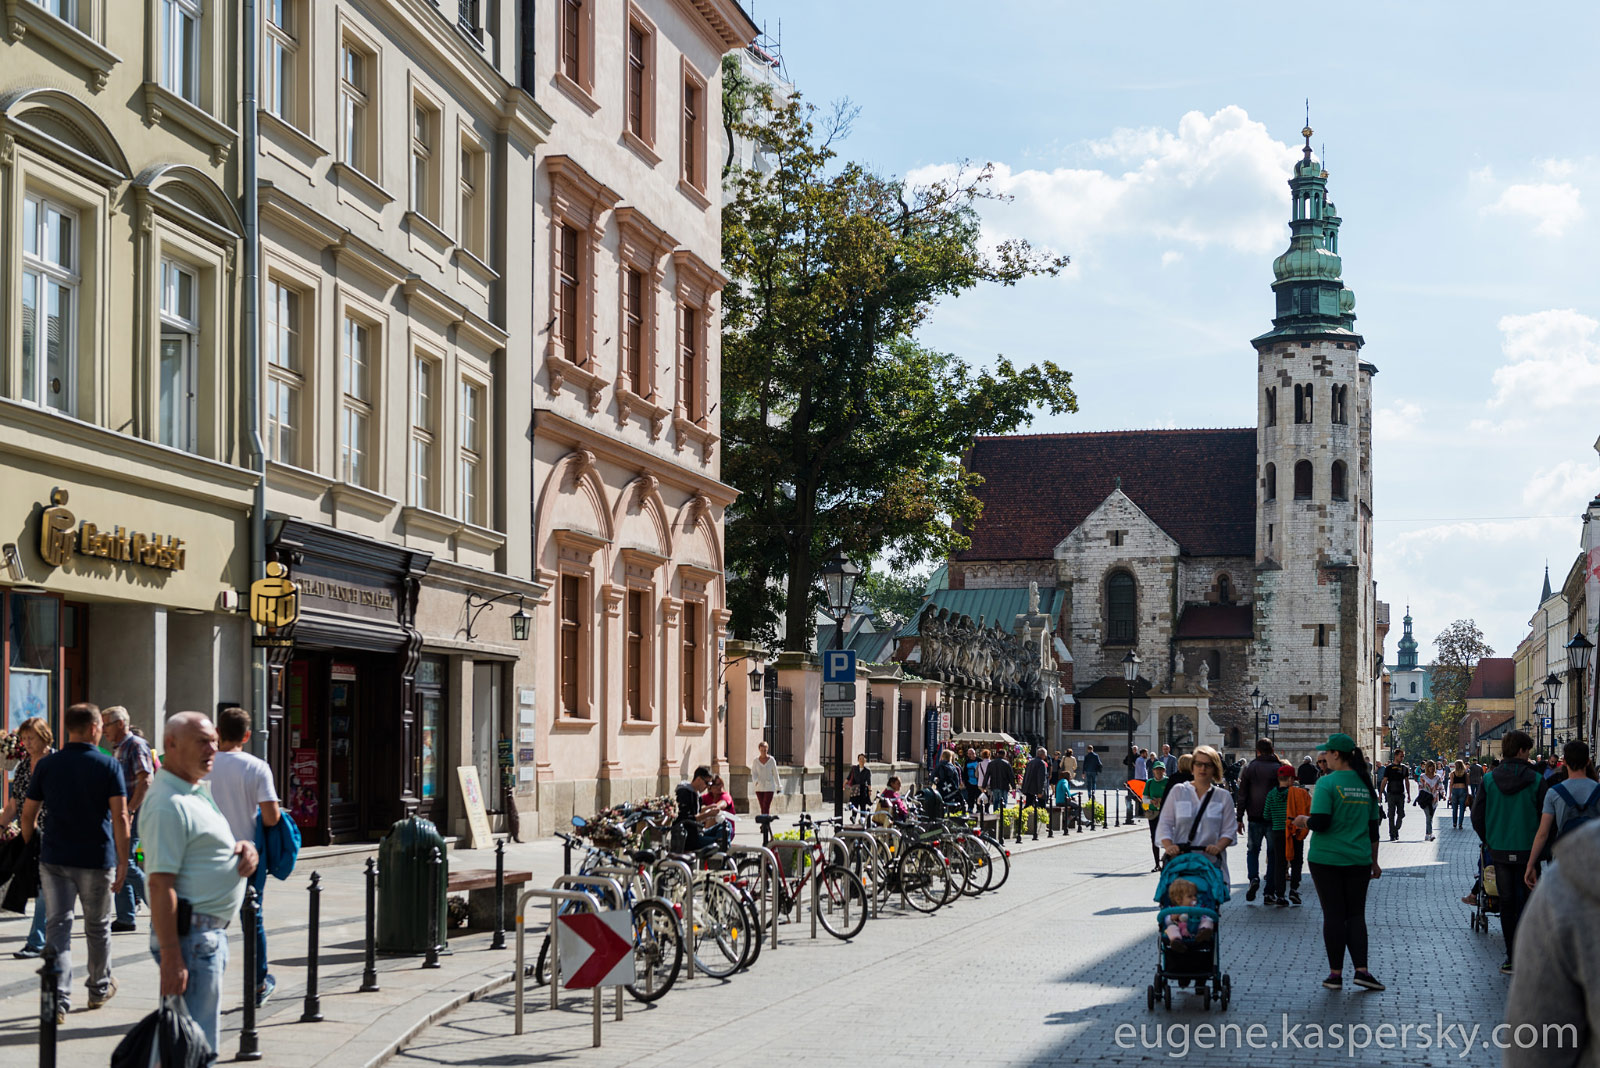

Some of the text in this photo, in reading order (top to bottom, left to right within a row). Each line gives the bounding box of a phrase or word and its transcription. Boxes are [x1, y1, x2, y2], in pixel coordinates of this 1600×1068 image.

[81, 522, 186, 571] Bank Polski
[831, 653, 848, 678] P
